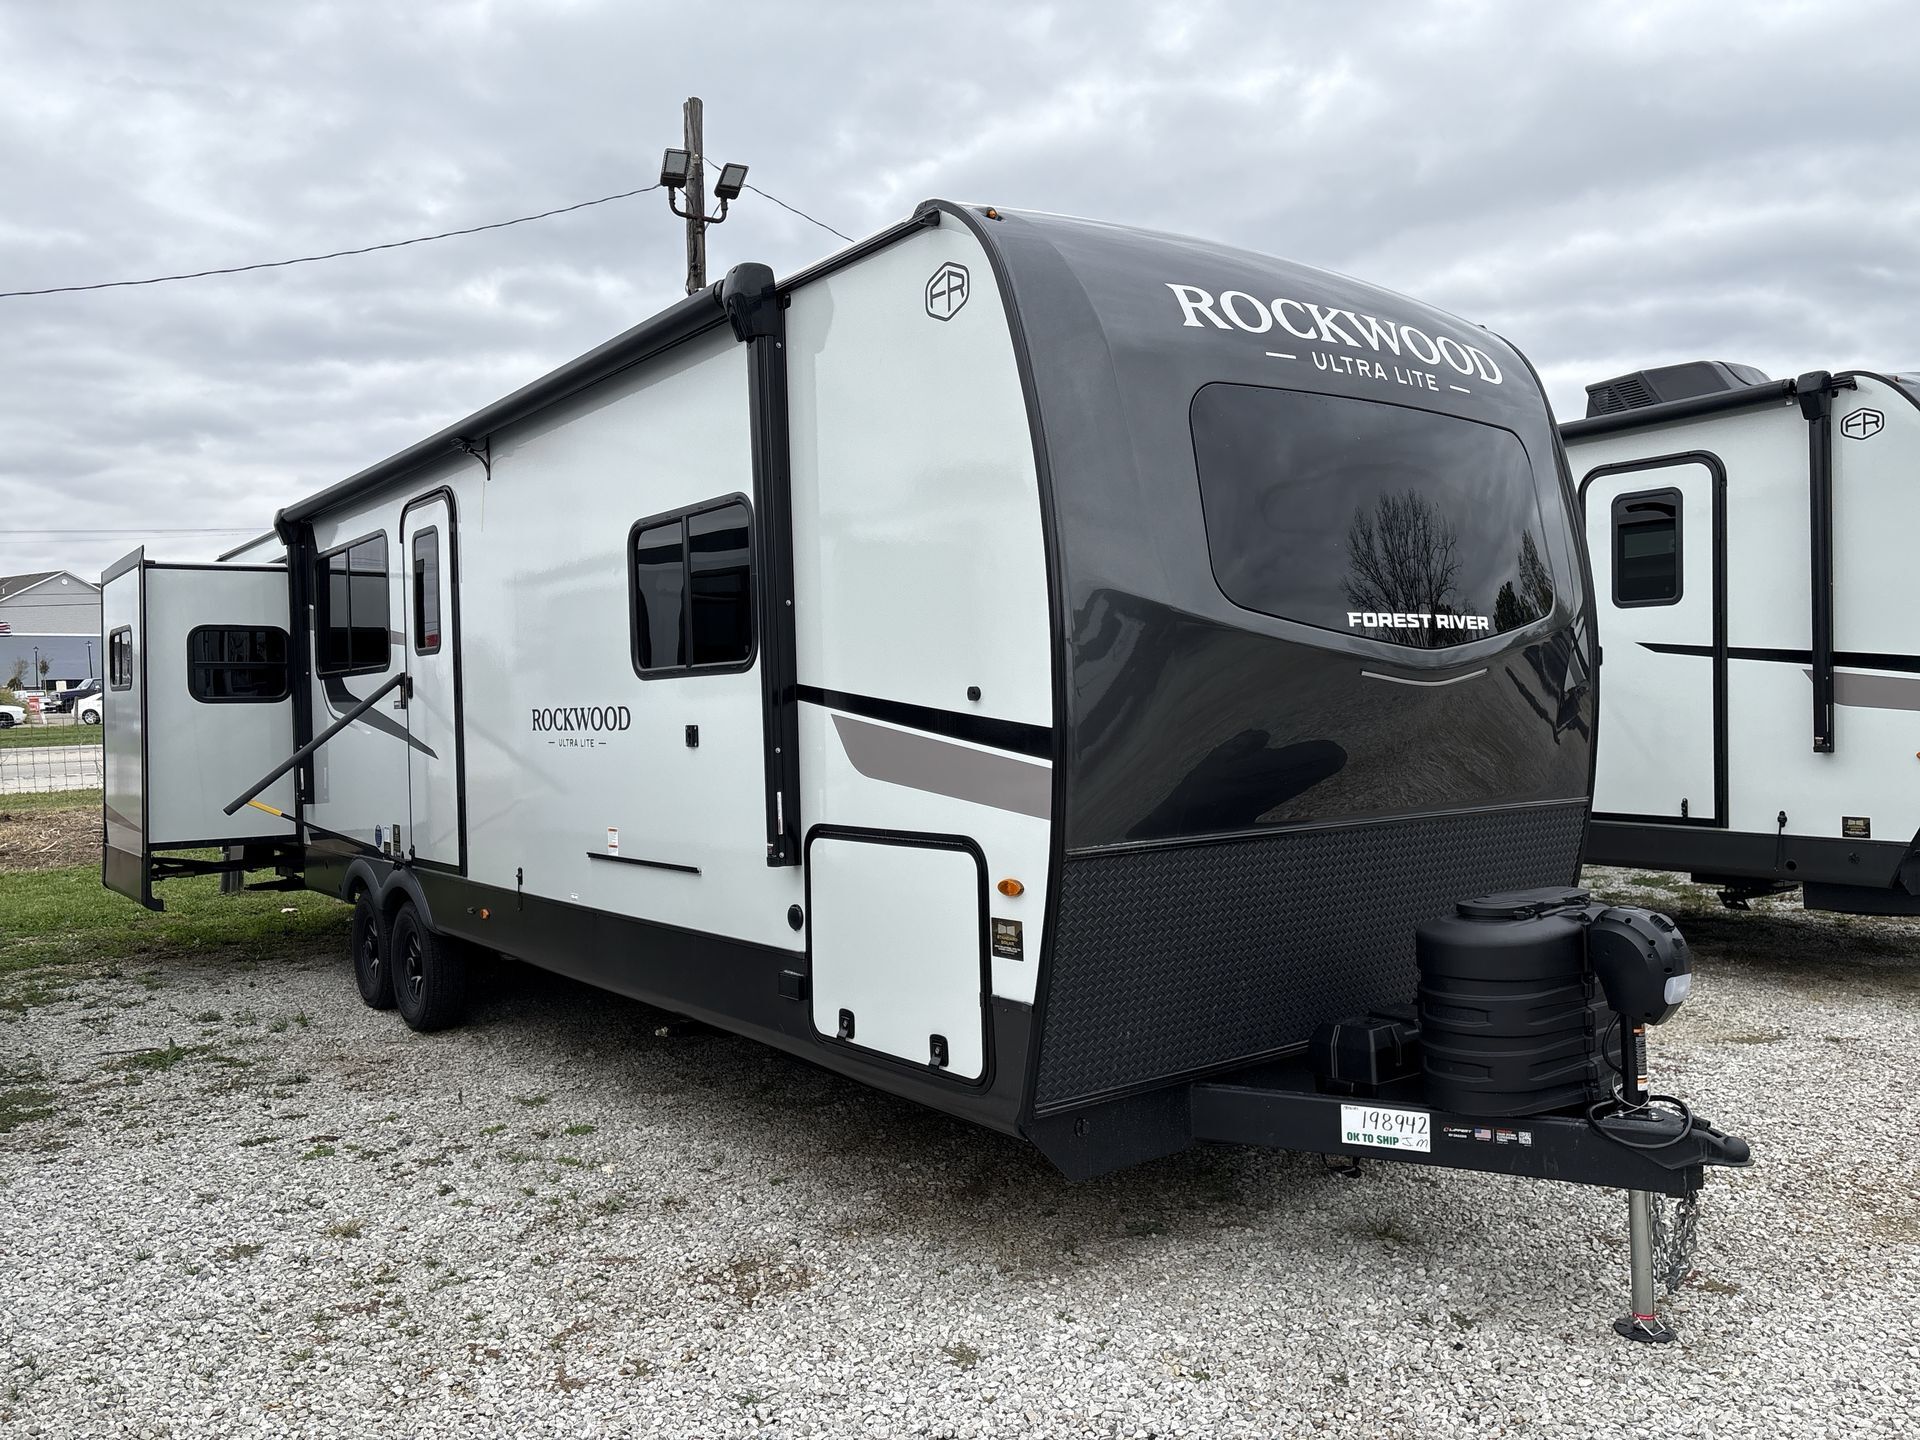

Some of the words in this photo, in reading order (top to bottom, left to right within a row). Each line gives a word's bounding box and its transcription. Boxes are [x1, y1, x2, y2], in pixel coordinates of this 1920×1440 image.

[1164, 282, 1503, 385] ROCKWOOD
[1311, 351, 1389, 382] ULTRA
[1394, 366, 1440, 391] LITE
[1346, 611, 1432, 629] FOREST
[1435, 614, 1490, 631] RIVER
[531, 706, 631, 731] ROCKWOOD
[558, 738, 578, 748] ULTRA
[580, 738, 595, 748] LITE
[1362, 1111, 1428, 1134] 198942
[1346, 1131, 1360, 1141] OK
[1362, 1133, 1374, 1143] TO
[1376, 1135, 1399, 1146] SHIP
